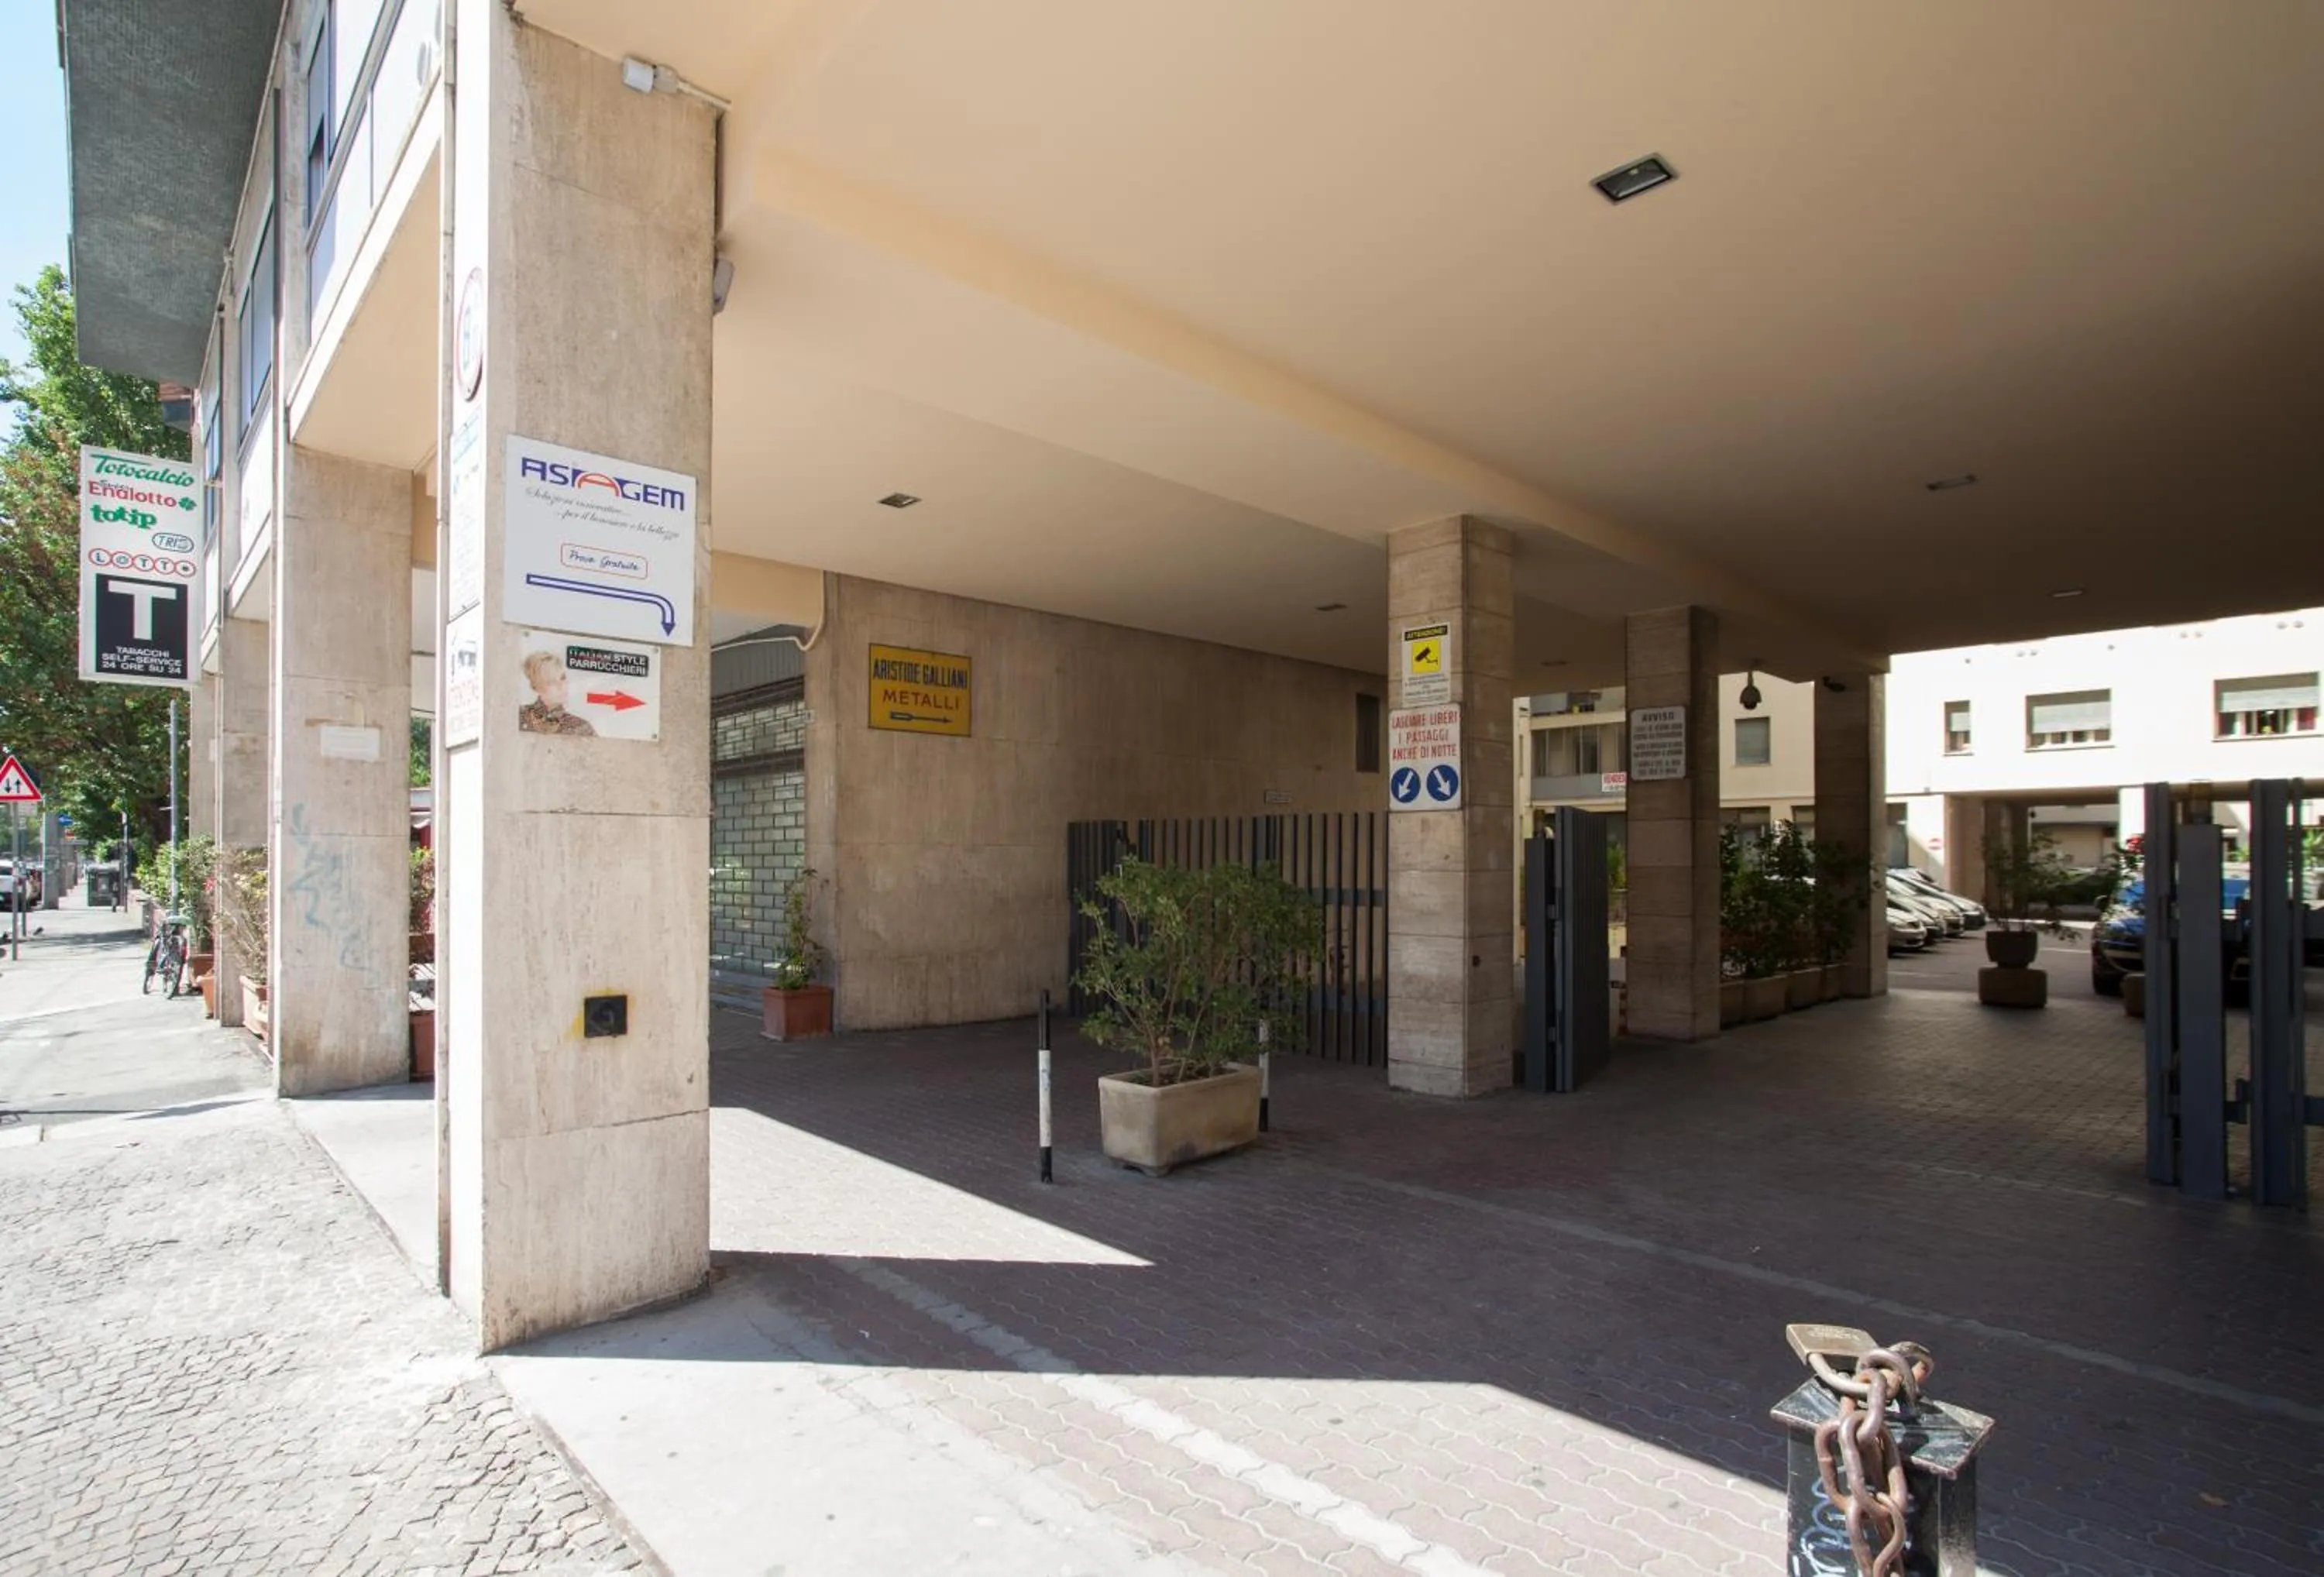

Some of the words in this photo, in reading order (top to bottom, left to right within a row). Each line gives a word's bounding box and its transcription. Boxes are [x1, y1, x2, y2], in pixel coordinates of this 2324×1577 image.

[90, 454, 194, 486] Totocalcio
[88, 480, 177, 507] Enalotto
[91, 504, 157, 529] totip
[91, 550, 193, 575] LOTTO
[108, 579, 177, 641] T
[115, 645, 170, 658] TABACCHI
[613, 654, 646, 665] STYLE
[120, 663, 145, 672] ORE
[569, 658, 646, 675] PARRUCCHIERI
[873, 658, 920, 684] ARISTIDE
[923, 664, 968, 689] GALLIANI
[882, 689, 959, 710] METALLI
[1429, 710, 1457, 726] LIBERI
[1406, 729, 1449, 744] PASSAGGI
[1431, 744, 1456, 758] NOTTE
